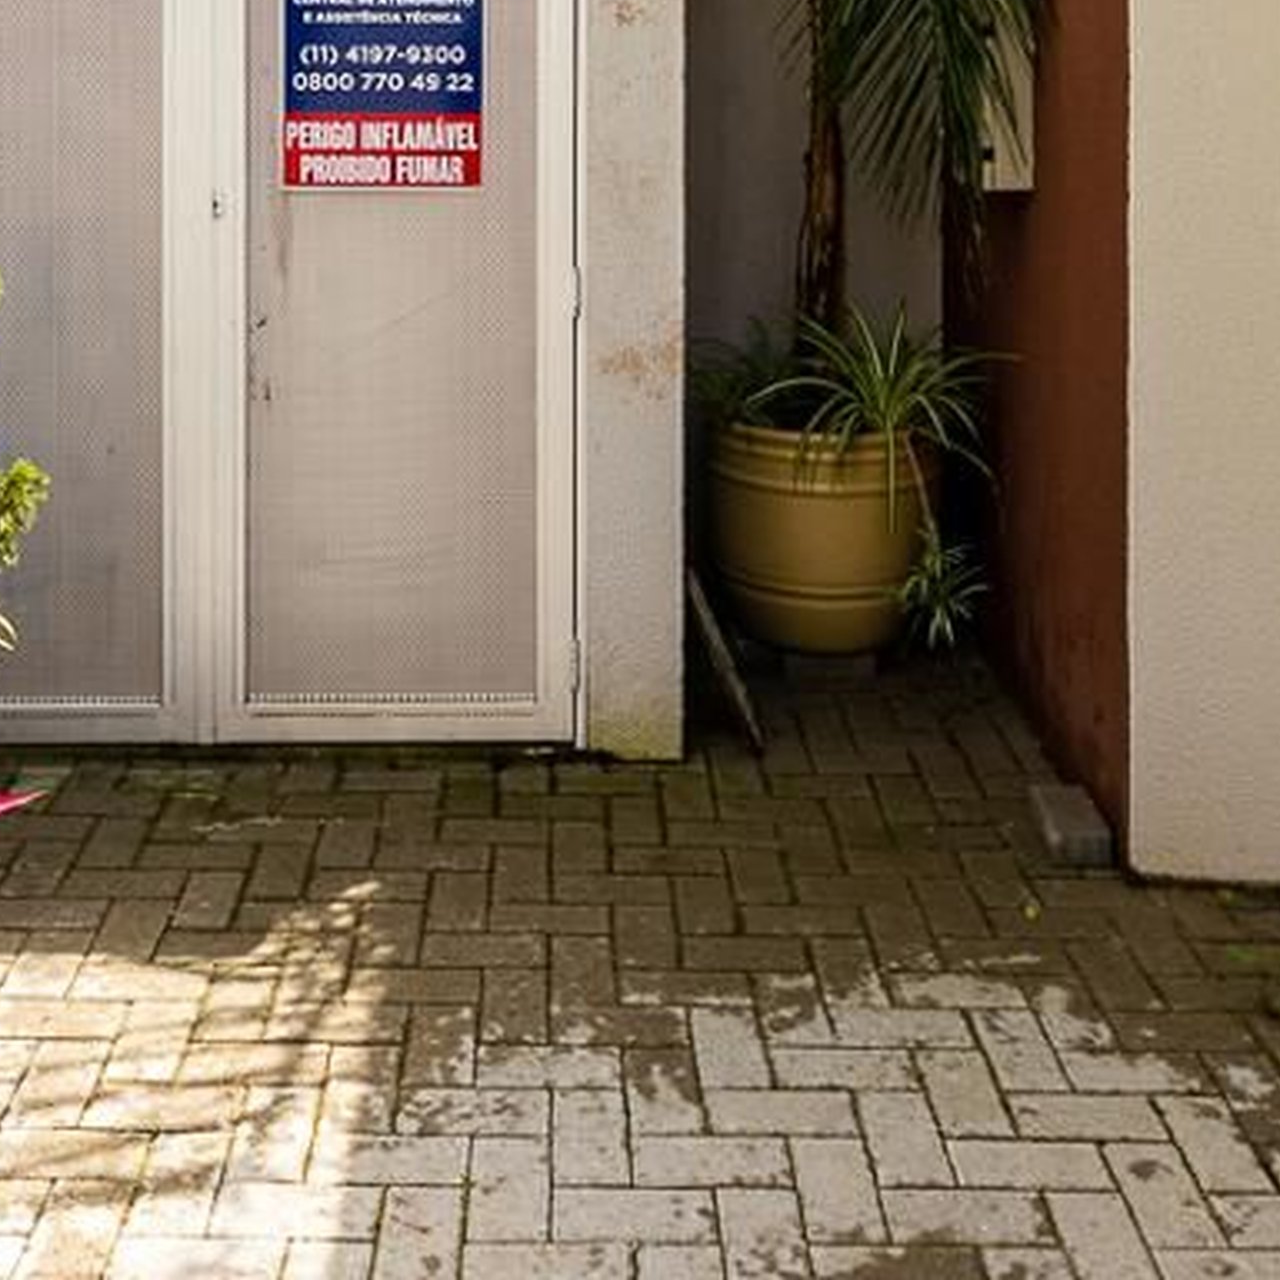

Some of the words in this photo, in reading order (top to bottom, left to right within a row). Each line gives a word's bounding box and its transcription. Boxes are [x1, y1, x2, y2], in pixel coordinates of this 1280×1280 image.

[299, 45, 339, 65] (11)
[292, 72, 355, 92] 0800
[360, 72, 404, 92] 770
[446, 72, 475, 92] 22
[286, 121, 356, 150] PERIGO
[360, 115, 478, 151] INFLAMÁVEL
[395, 156, 465, 183] FUMAR
